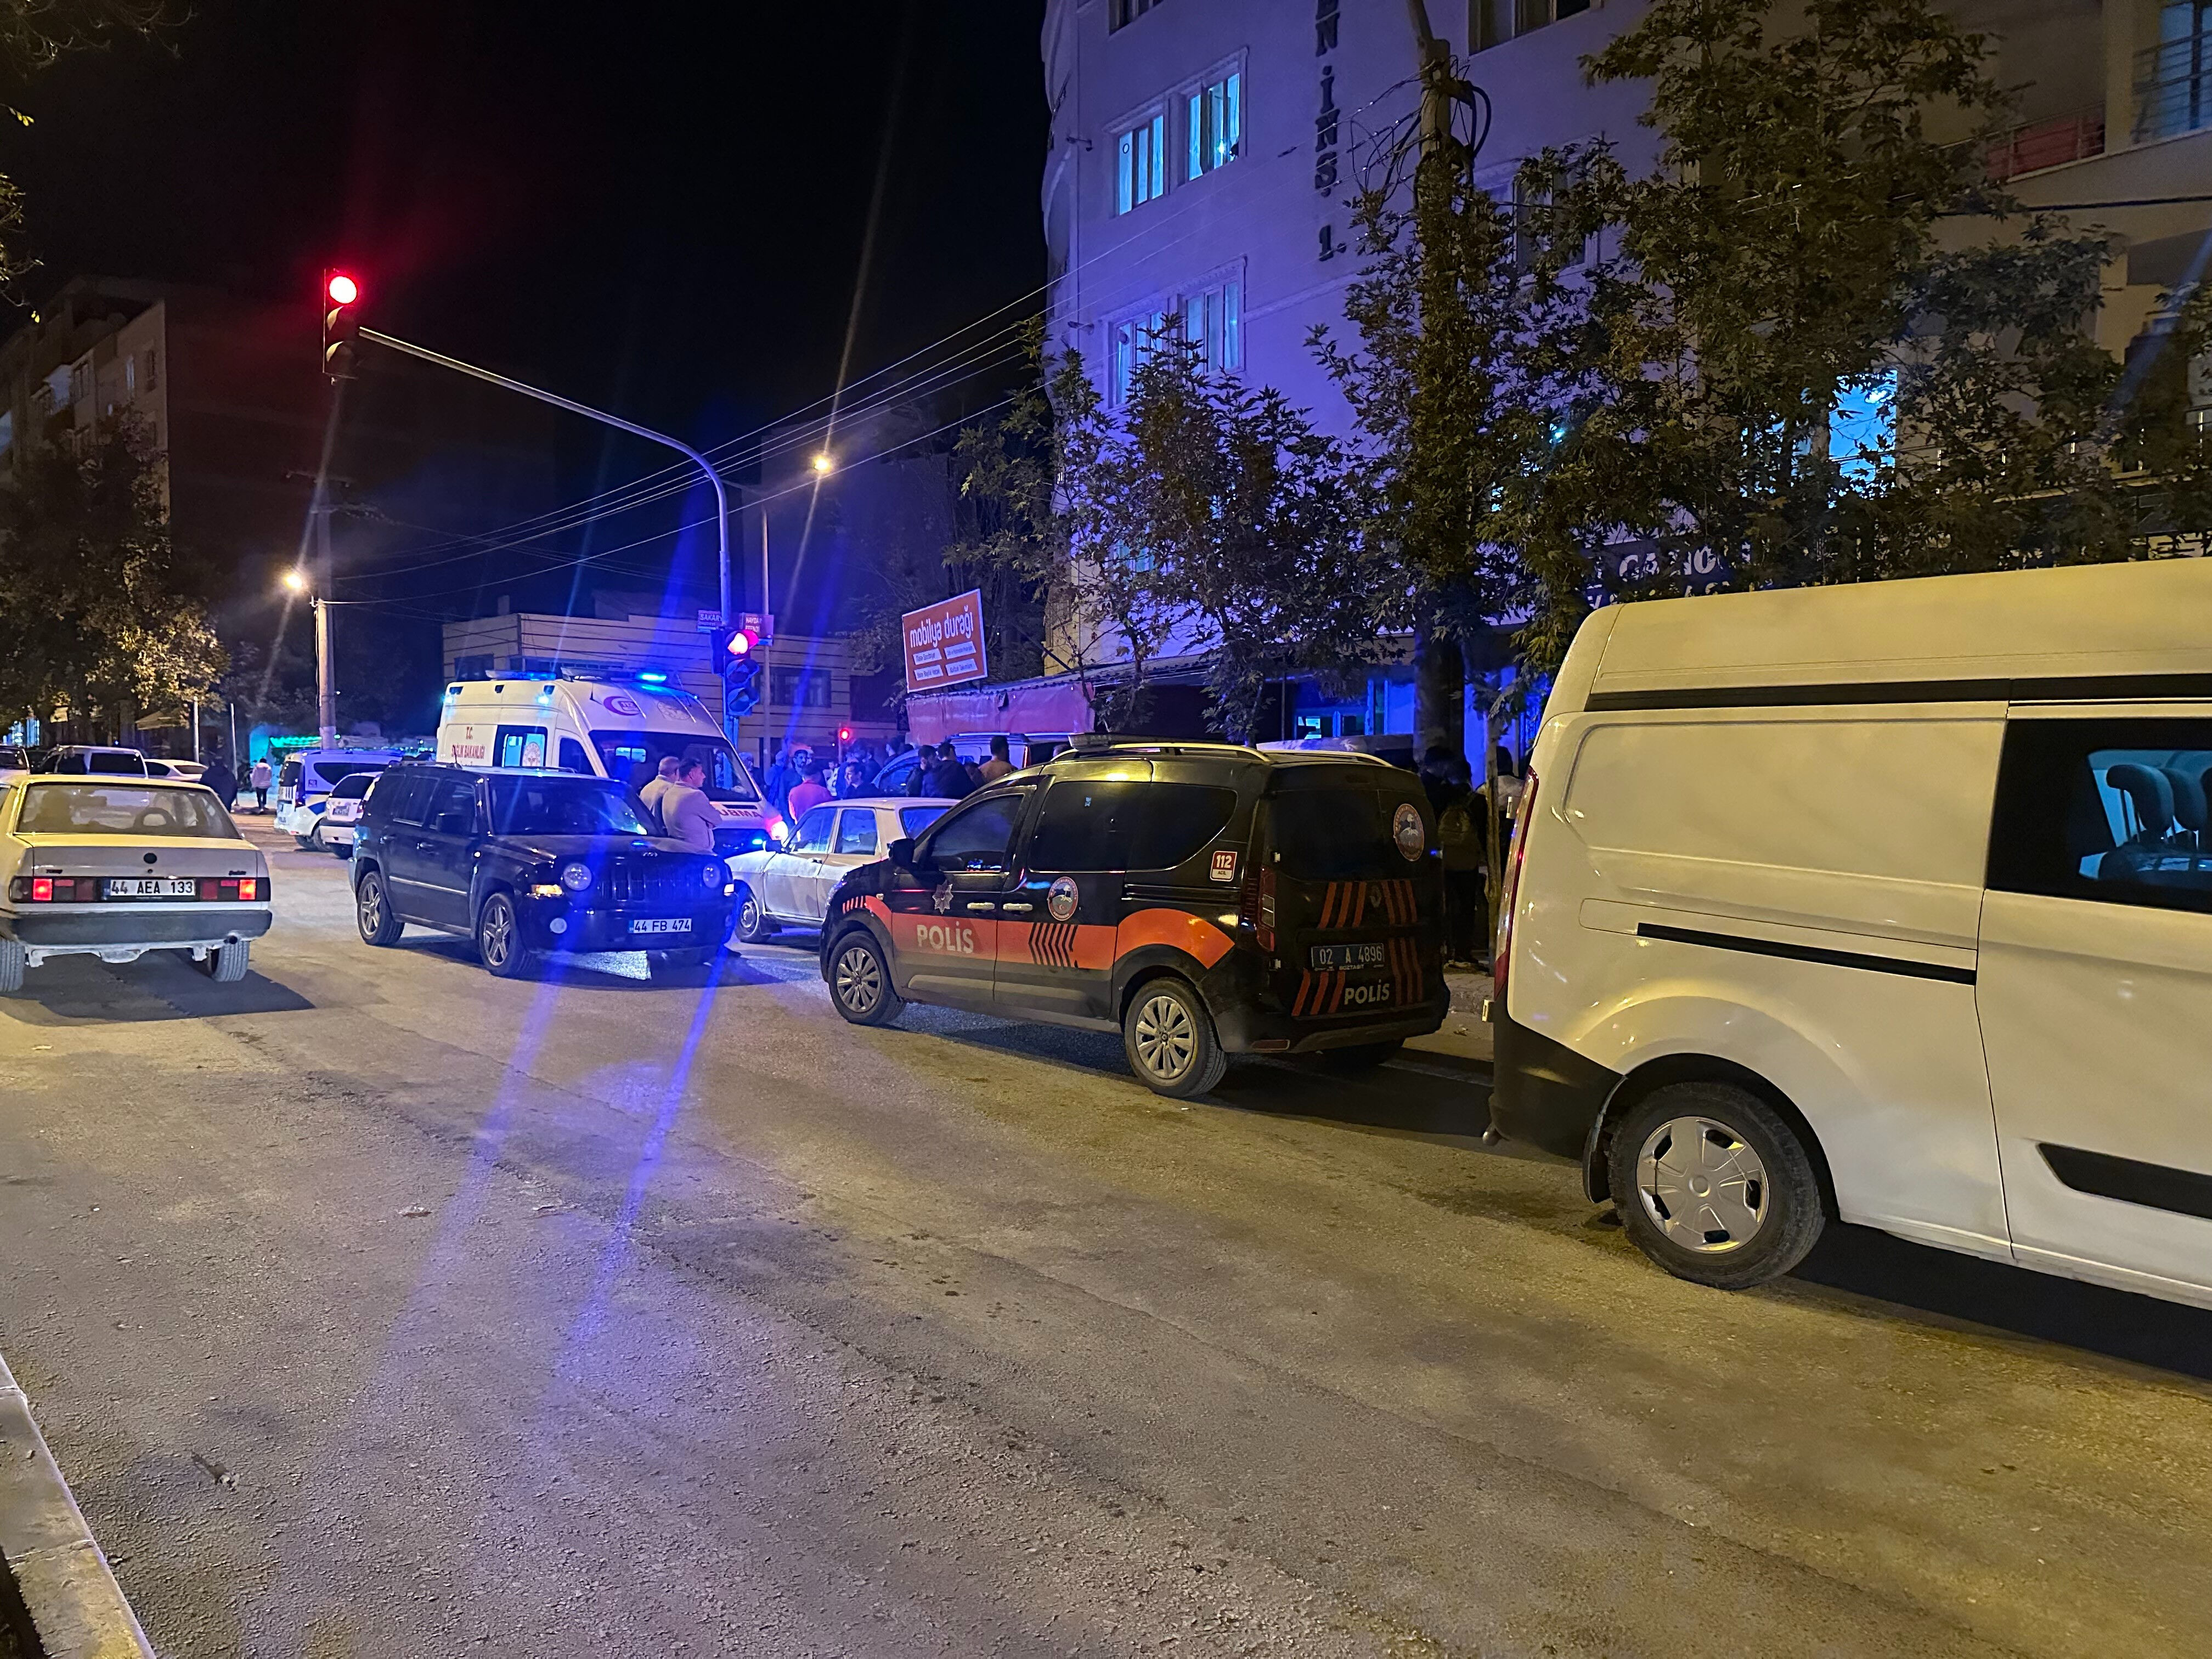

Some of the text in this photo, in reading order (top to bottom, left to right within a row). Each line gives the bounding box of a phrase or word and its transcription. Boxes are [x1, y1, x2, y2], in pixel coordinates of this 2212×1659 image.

[699, 613, 723, 622] SAKARY
[910, 605, 974, 648] mobilya durağı
[1216, 855, 1232, 868] 112
[111, 881, 193, 894] 44 AEA 133
[635, 919, 690, 932] 44 FB 474
[917, 921, 974, 953] POLİS
[1319, 946, 1383, 965] 02 A 4896
[1344, 979, 1390, 1005] POLİS
